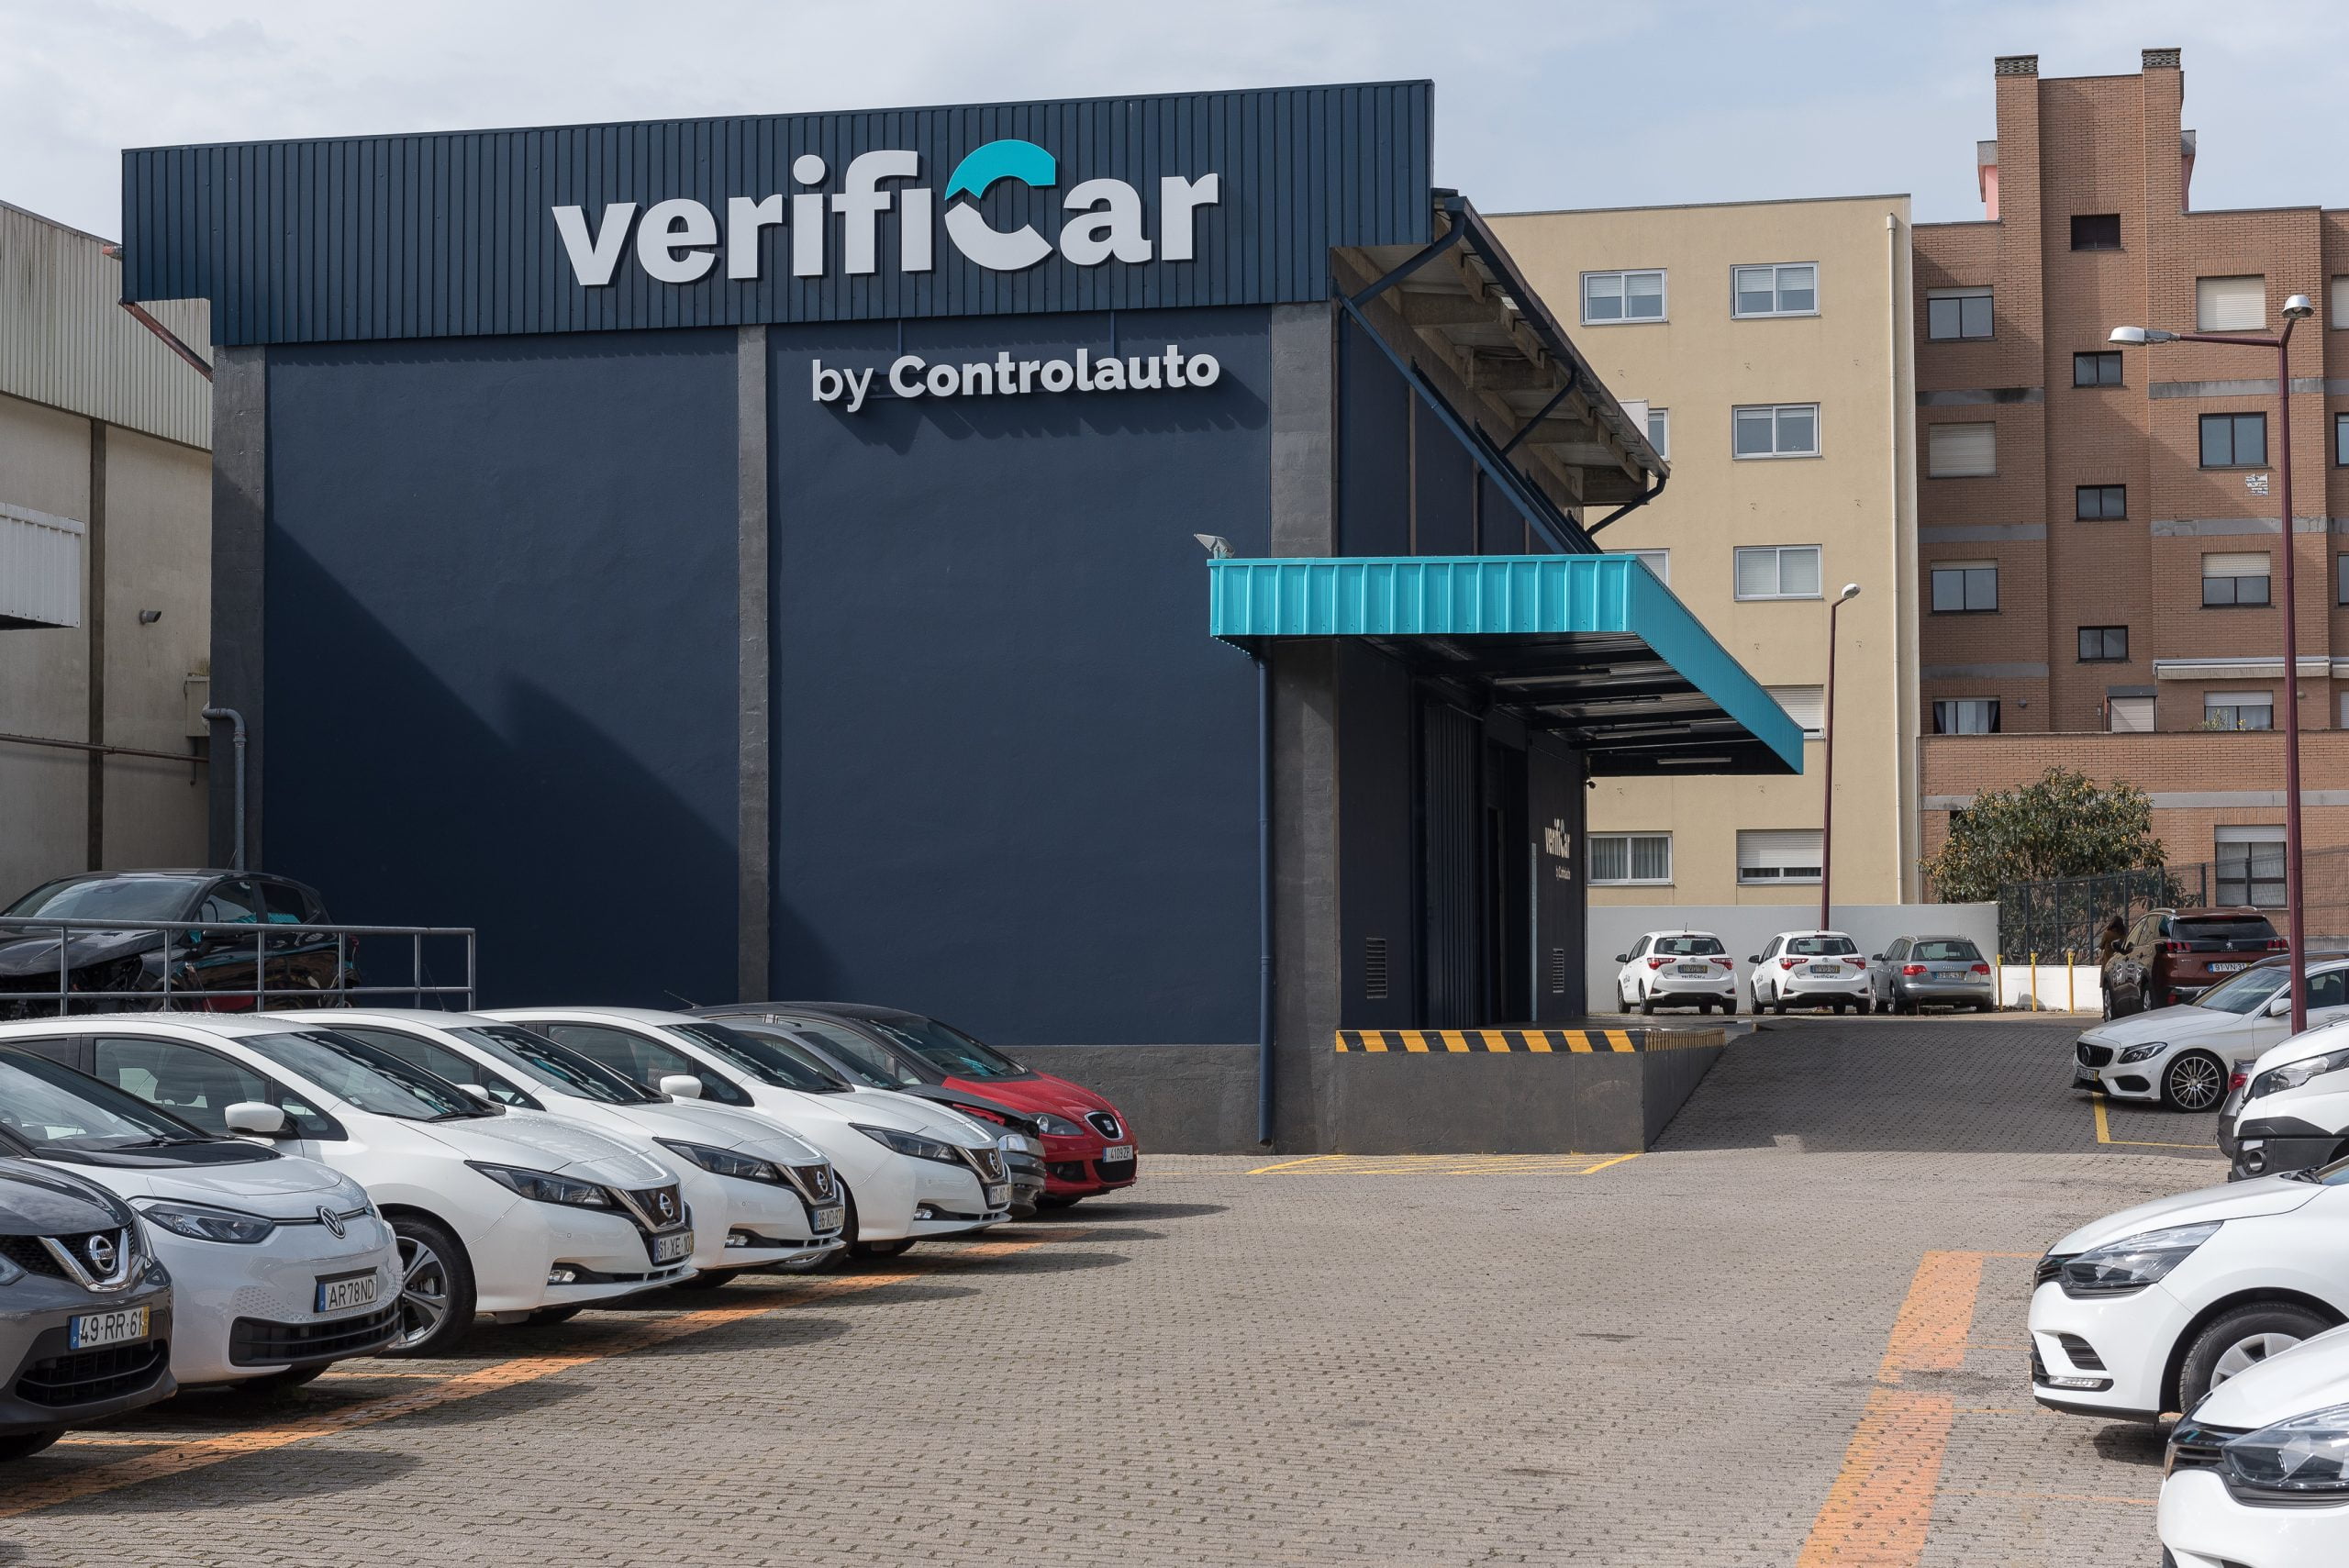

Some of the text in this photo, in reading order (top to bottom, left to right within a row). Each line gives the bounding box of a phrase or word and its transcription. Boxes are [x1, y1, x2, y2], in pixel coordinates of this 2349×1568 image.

[551, 139, 1219, 286] verifiCar
[812, 344, 1220, 412] by Controlauto
